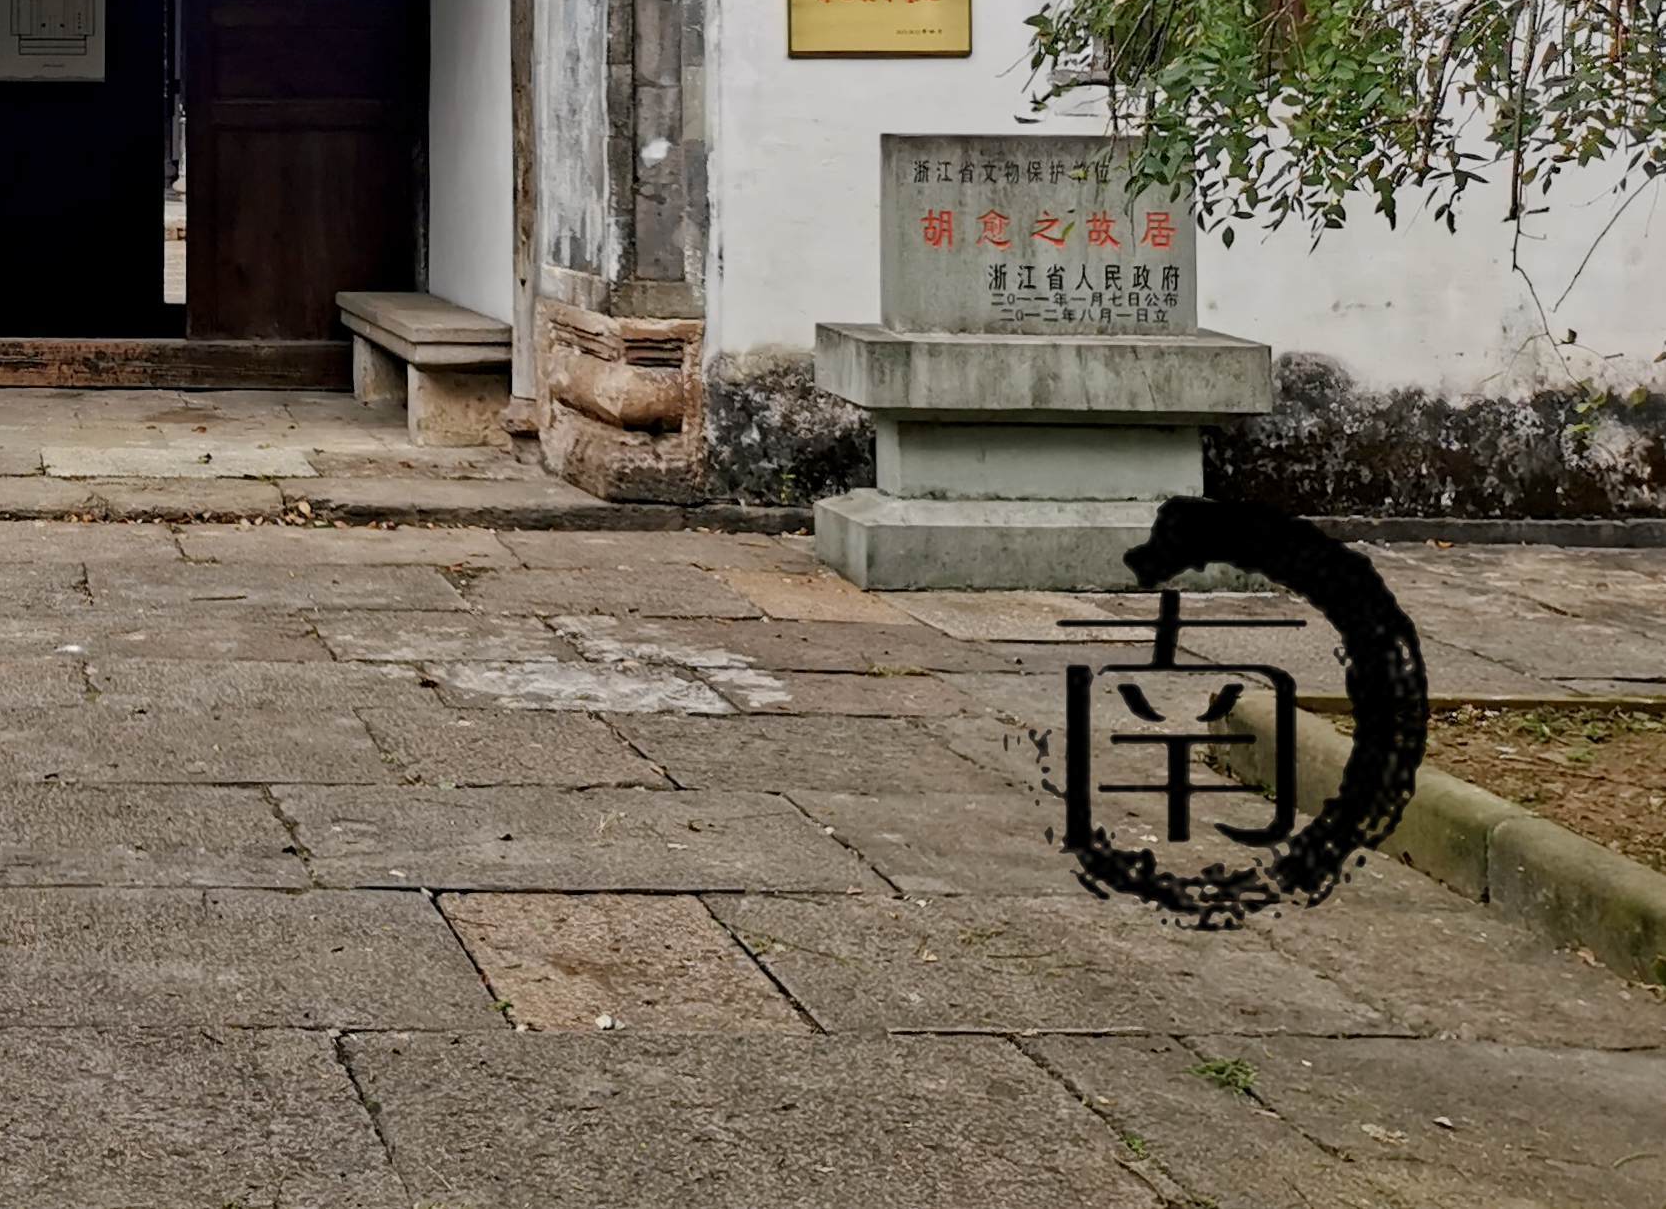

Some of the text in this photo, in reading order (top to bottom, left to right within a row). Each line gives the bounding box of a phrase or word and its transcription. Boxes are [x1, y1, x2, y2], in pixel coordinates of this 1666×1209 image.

[913, 160, 1112, 184] 浙江省文物保护单位
[920, 208, 1179, 252] 胡愈之故居
[987, 263, 1181, 292] 浙江省人民政府
